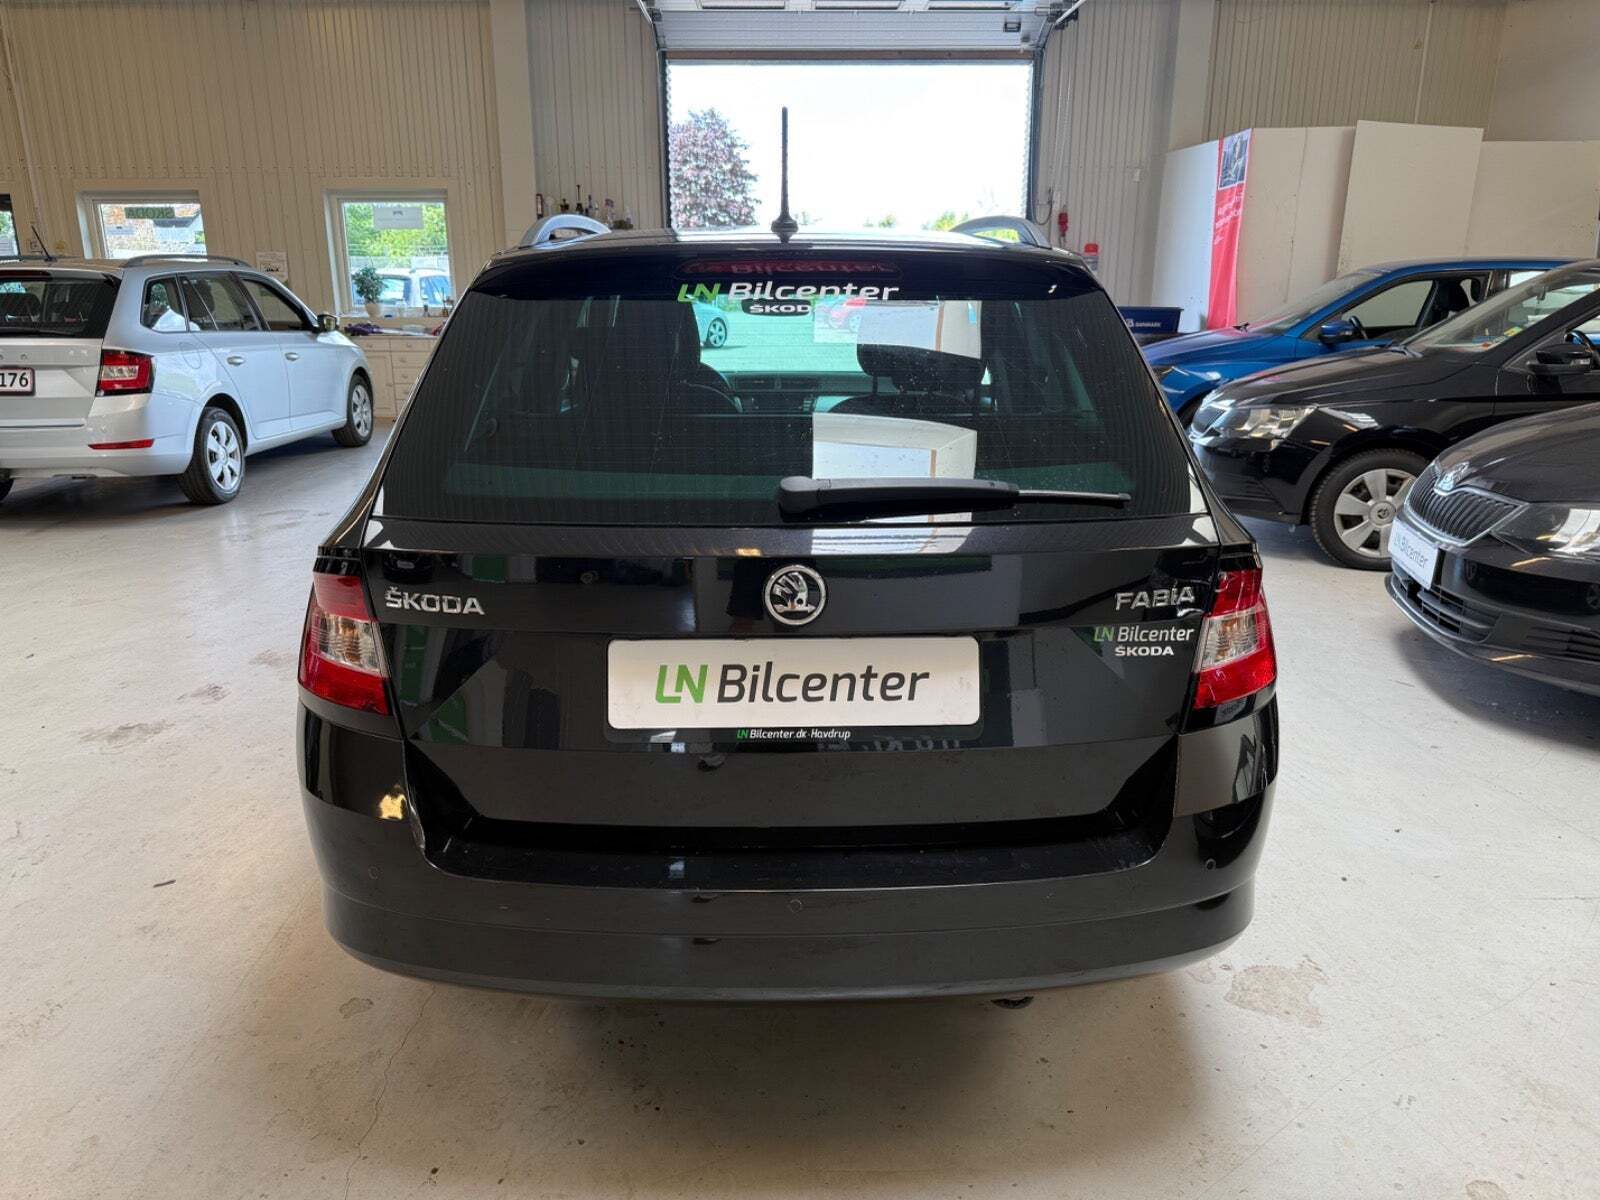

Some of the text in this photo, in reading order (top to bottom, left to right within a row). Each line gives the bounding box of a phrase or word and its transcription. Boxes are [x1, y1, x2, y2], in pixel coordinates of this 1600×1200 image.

[677, 281, 899, 301] LN Bilcenter
[749, 304, 813, 313] ŠKOD
[385, 586, 485, 615] ŠKODA
[1115, 587, 1195, 610] FABIA
[1094, 625, 1194, 642] LN Bilcenter
[1115, 645, 1174, 656] ŠKODA
[655, 661, 929, 704] LN Bilcenter
[736, 730, 748, 739] LN
